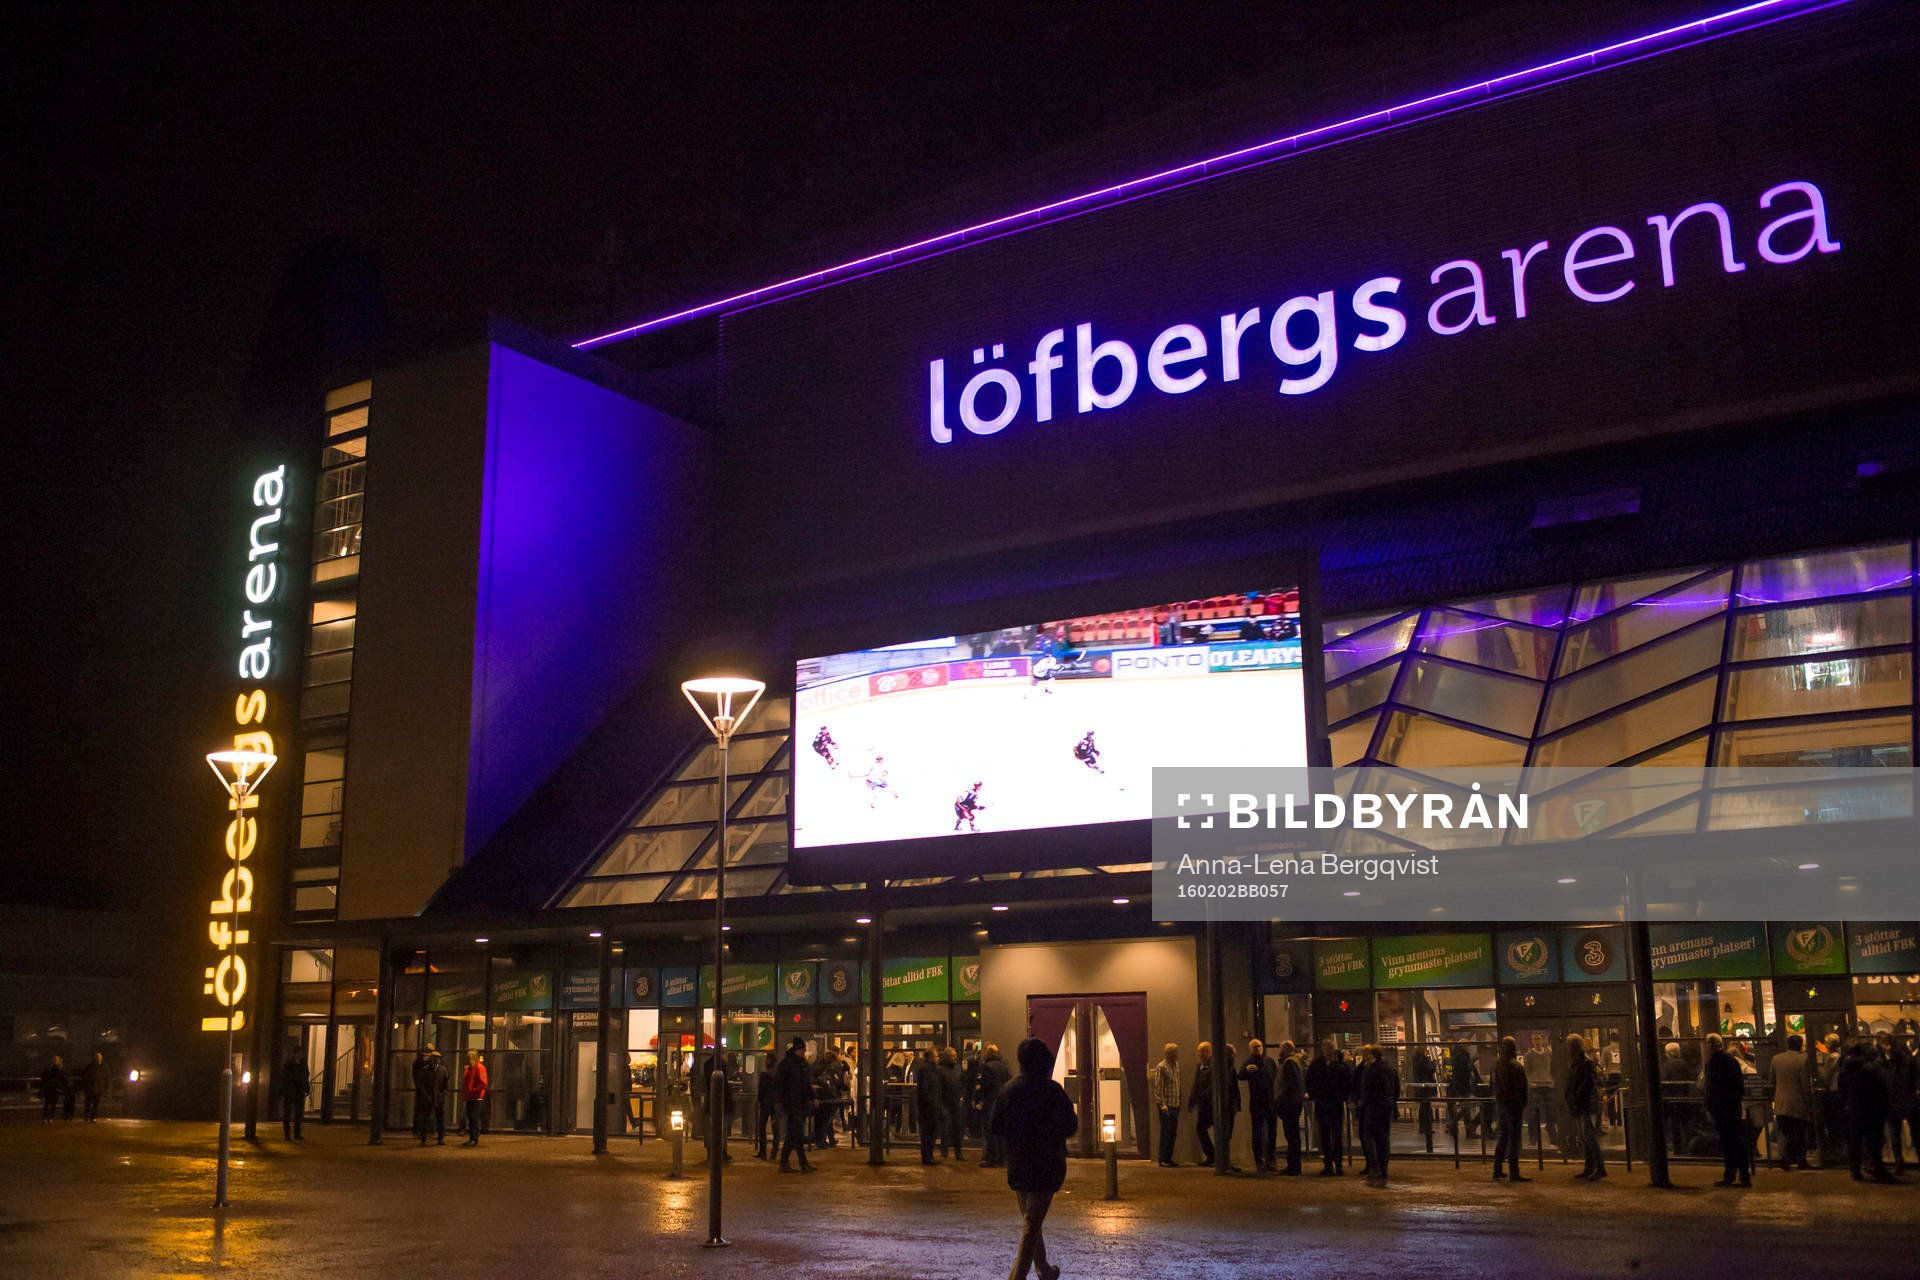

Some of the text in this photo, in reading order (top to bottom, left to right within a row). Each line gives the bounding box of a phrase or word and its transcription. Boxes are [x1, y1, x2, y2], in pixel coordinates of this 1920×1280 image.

[1117, 653, 1203, 670] PONTO
[1651, 935, 1713, 956] nn arenans
[1711, 936, 1756, 959] platser!
[1381, 946, 1447, 967] Vinn arenans
[1388, 946, 1483, 980] grymmaste platser!
[926, 965, 944, 978] FBK
